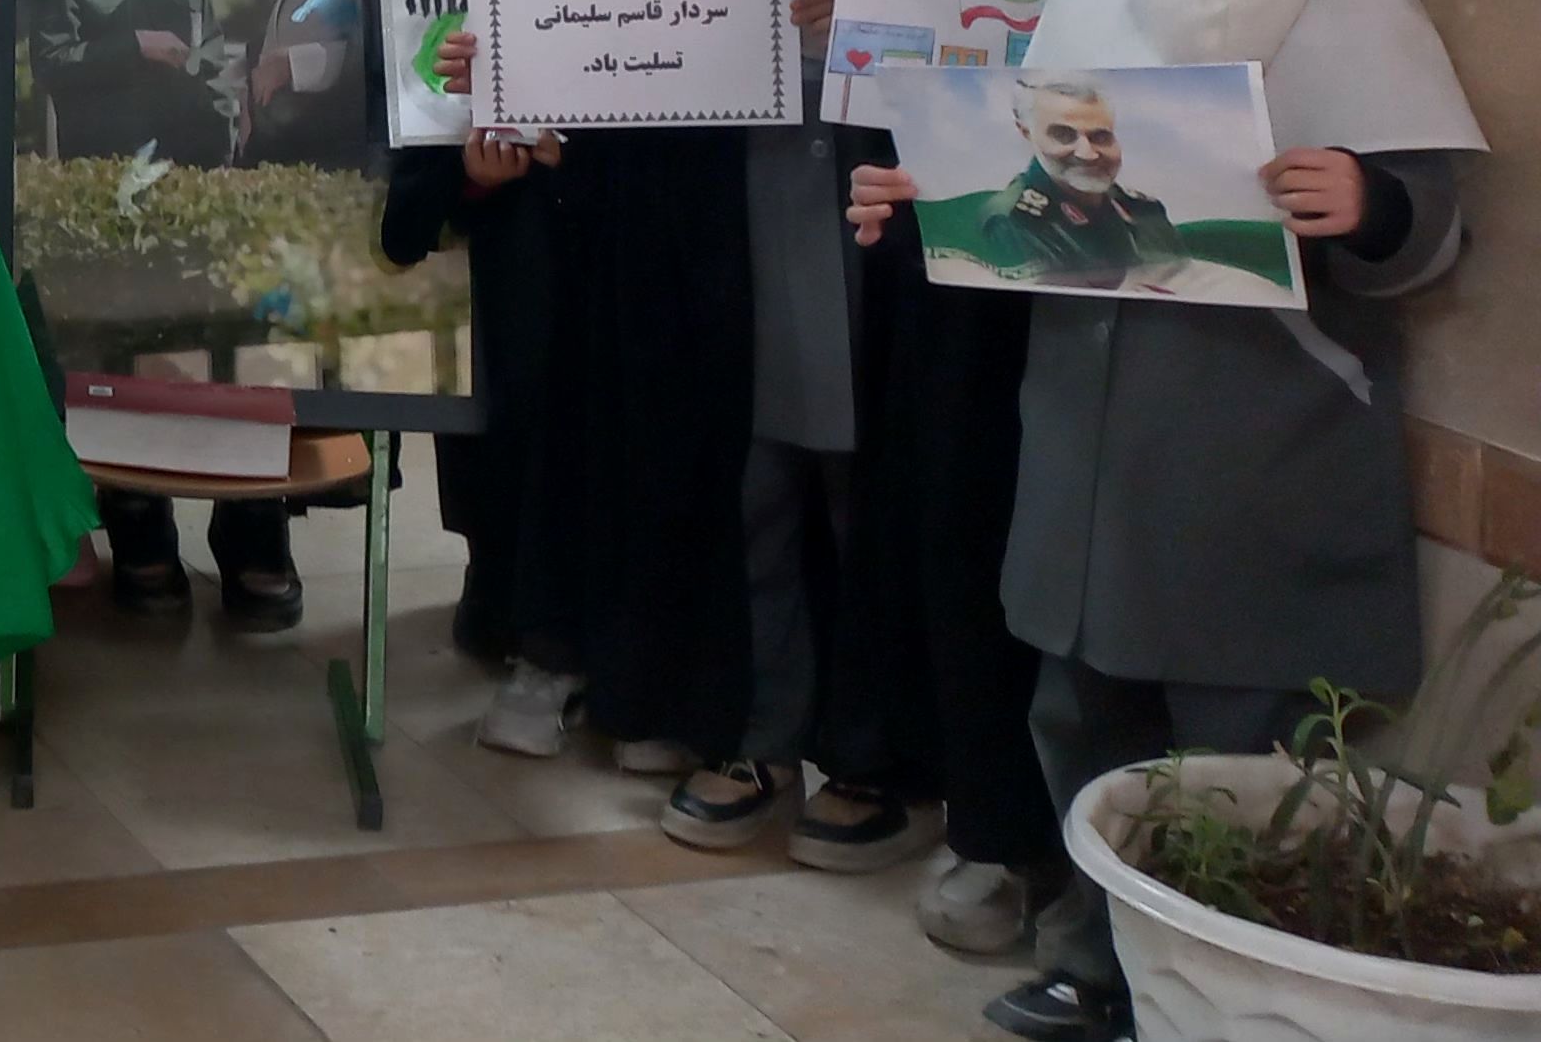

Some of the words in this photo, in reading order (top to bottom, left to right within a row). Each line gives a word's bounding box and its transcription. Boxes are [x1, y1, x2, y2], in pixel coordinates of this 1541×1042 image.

[534, 3, 612, 31] سلیمانی
[617, 0, 663, 28] قاسم
[669, 1, 729, 27] سردار
[583, 52, 618, 78] باد.
[624, 50, 684, 76] تسلیت
